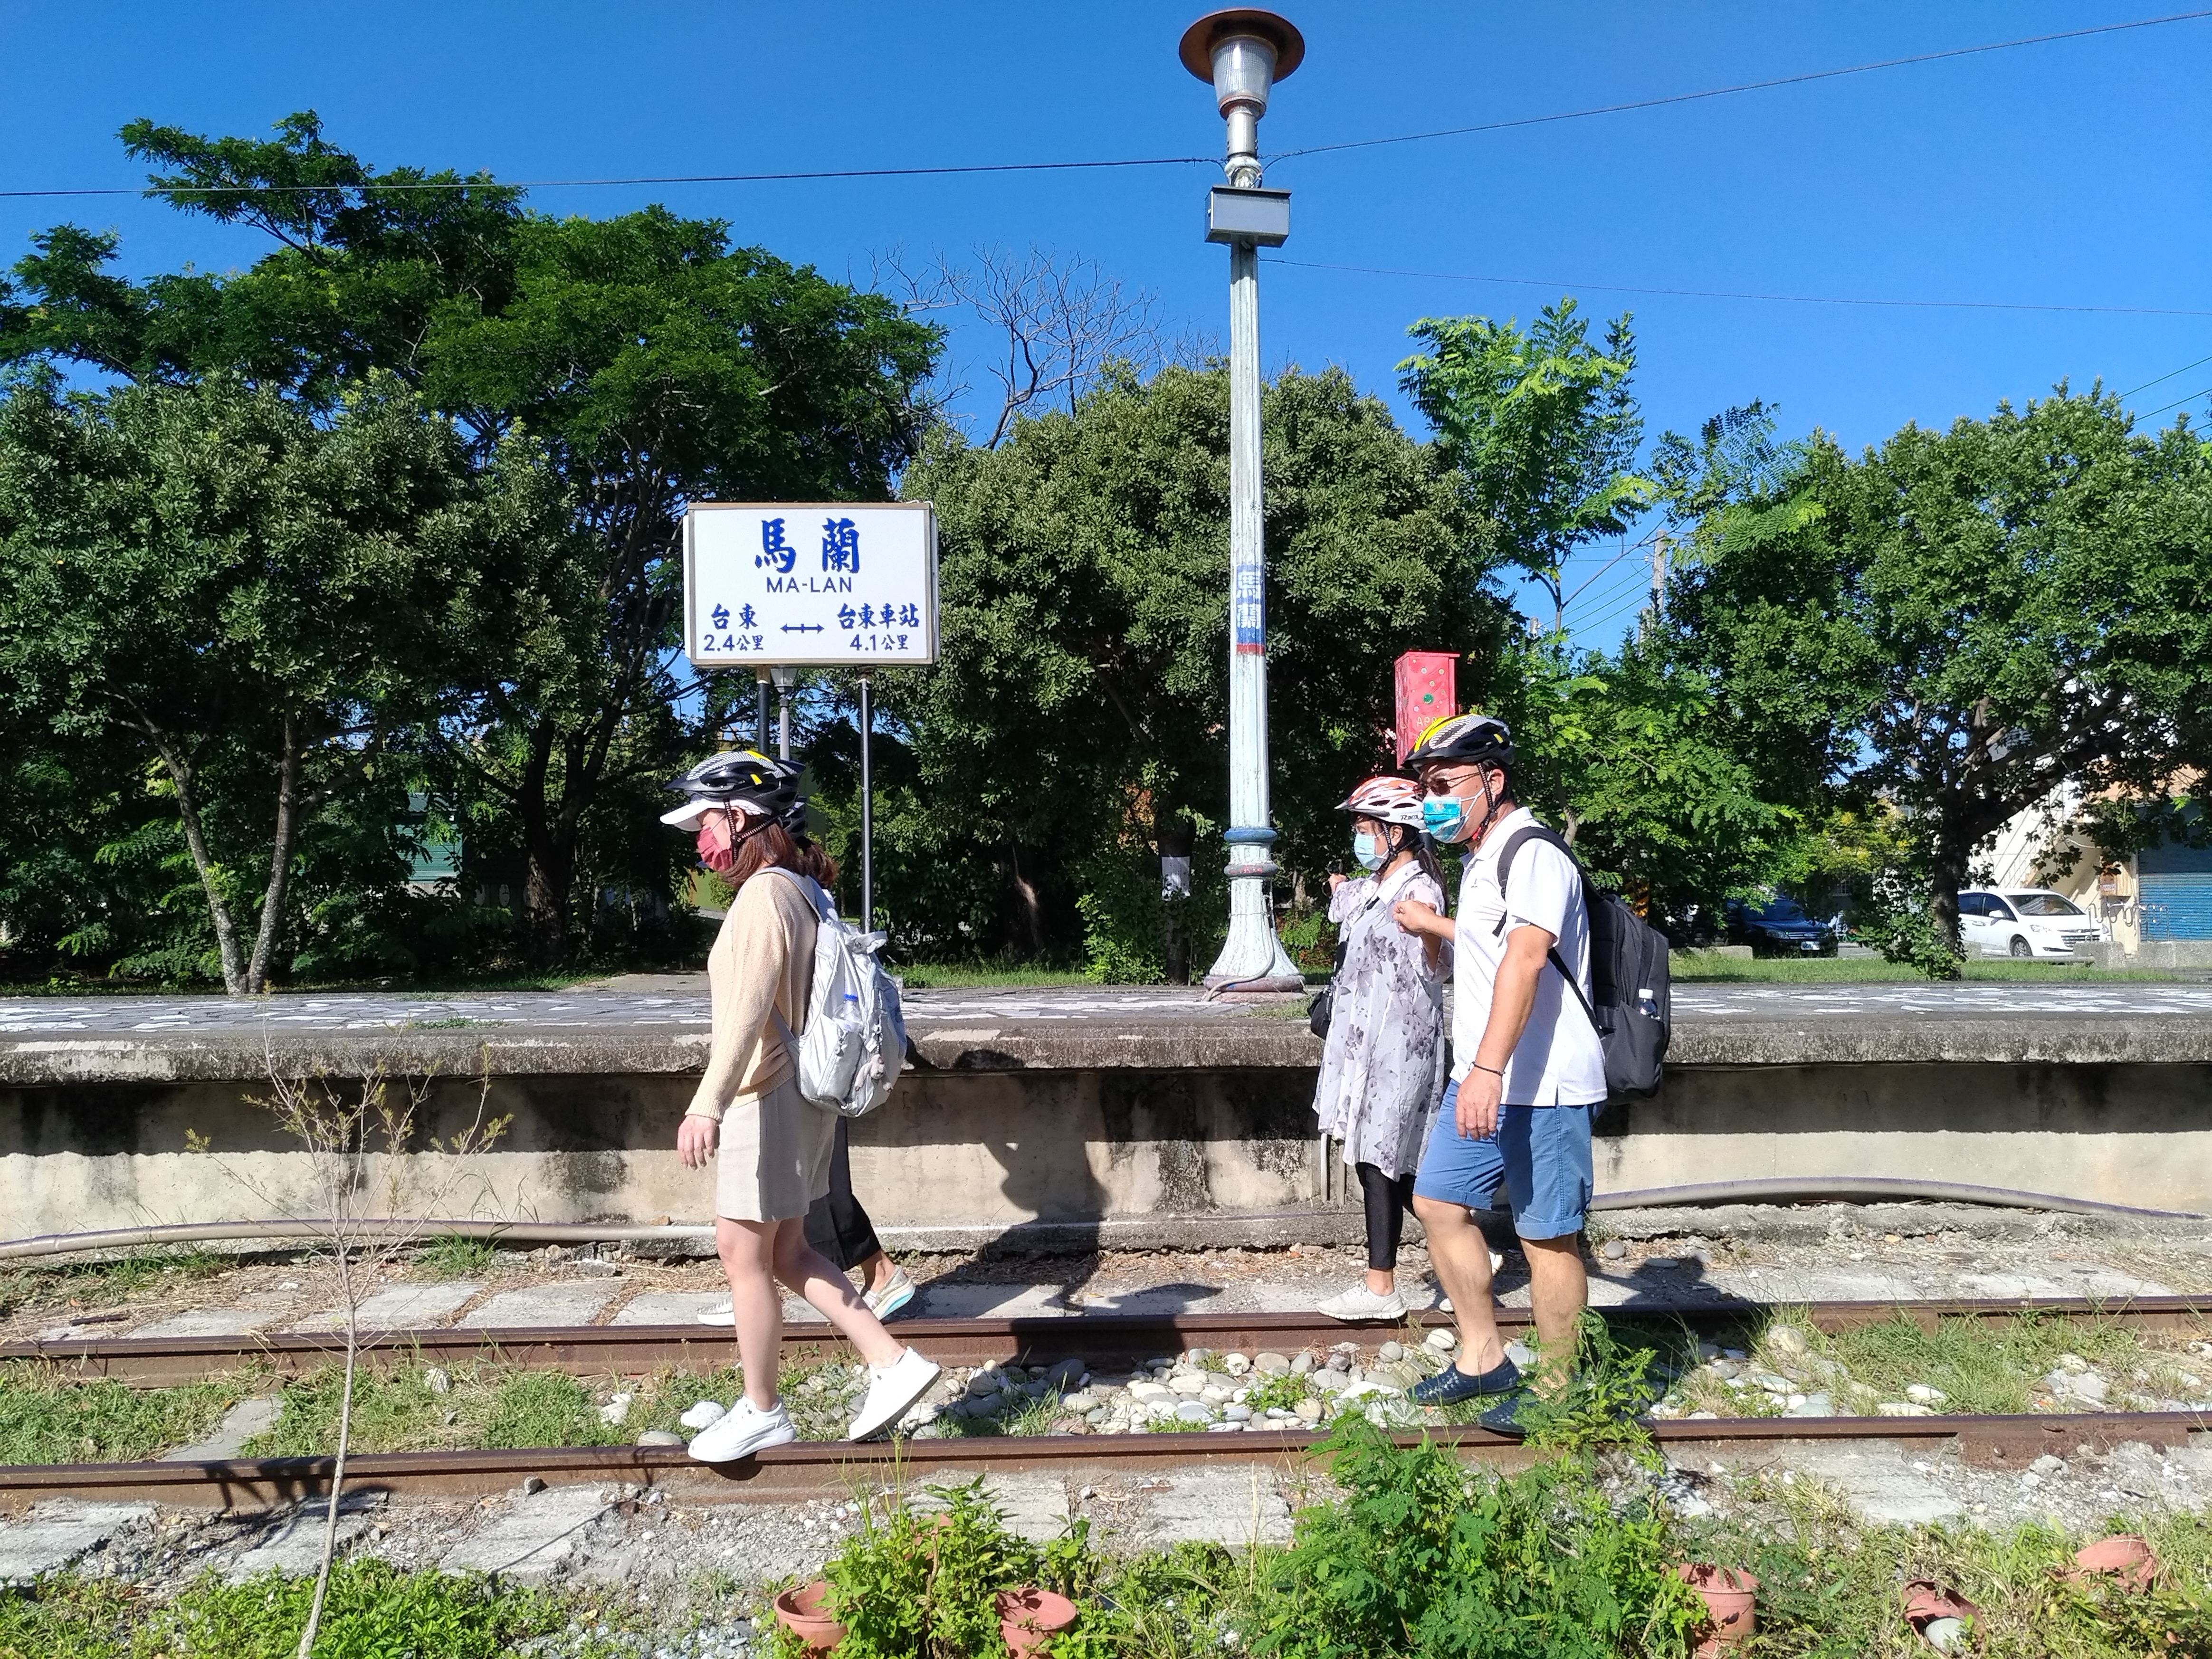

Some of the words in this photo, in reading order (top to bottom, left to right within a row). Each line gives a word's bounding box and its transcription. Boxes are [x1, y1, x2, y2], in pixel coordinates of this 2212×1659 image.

[754, 517, 860, 574] 馬蘭
[766, 577, 852, 593] MA-LAN
[711, 603, 759, 630] 台東
[837, 603, 920, 630] 台東車站
